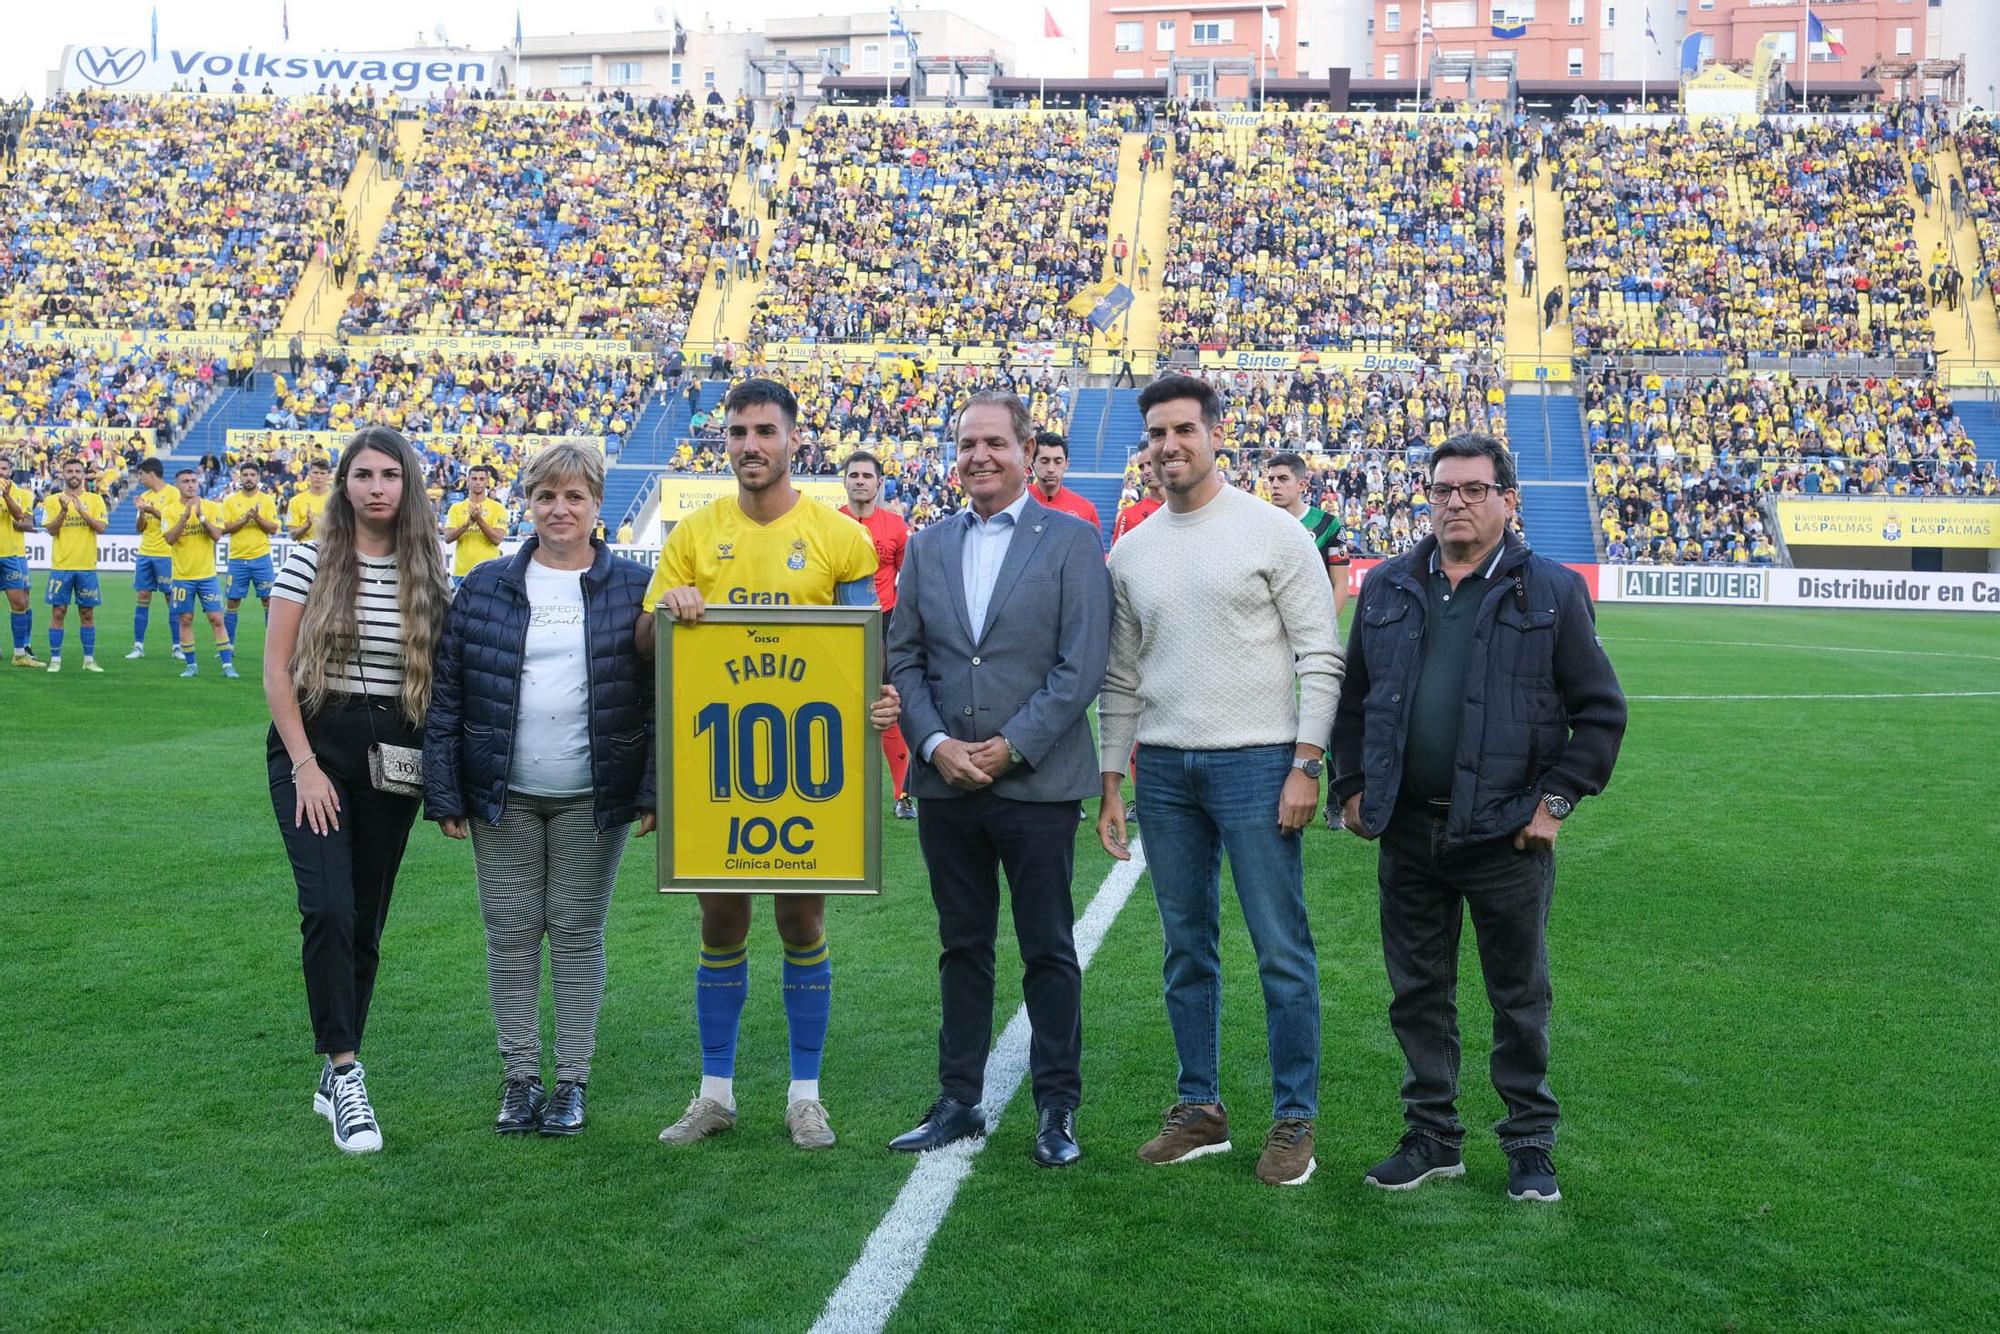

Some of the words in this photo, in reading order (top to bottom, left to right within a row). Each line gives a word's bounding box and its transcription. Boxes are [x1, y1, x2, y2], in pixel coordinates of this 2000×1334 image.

[170, 50, 488, 91] Volkswagen
[384, 338, 415, 347] HPS
[428, 339, 458, 348] HPS
[471, 340, 502, 349] HPS
[553, 341, 584, 351] HPS
[596, 342, 627, 351] HPS
[1237, 352, 1289, 368] Binter
[172, 587, 186, 602] 10
[728, 587, 790, 605] Gran
[1627, 573, 1760, 598] ATEFUER
[1799, 576, 1930, 601] Distribuidor
[1938, 586, 1963, 602] en
[724, 653, 807, 686] FABIO
[693, 701, 844, 804] 100
[727, 816, 815, 855] IOC
[725, 858, 770, 870] Clínica
[774, 858, 817, 870] Dental
